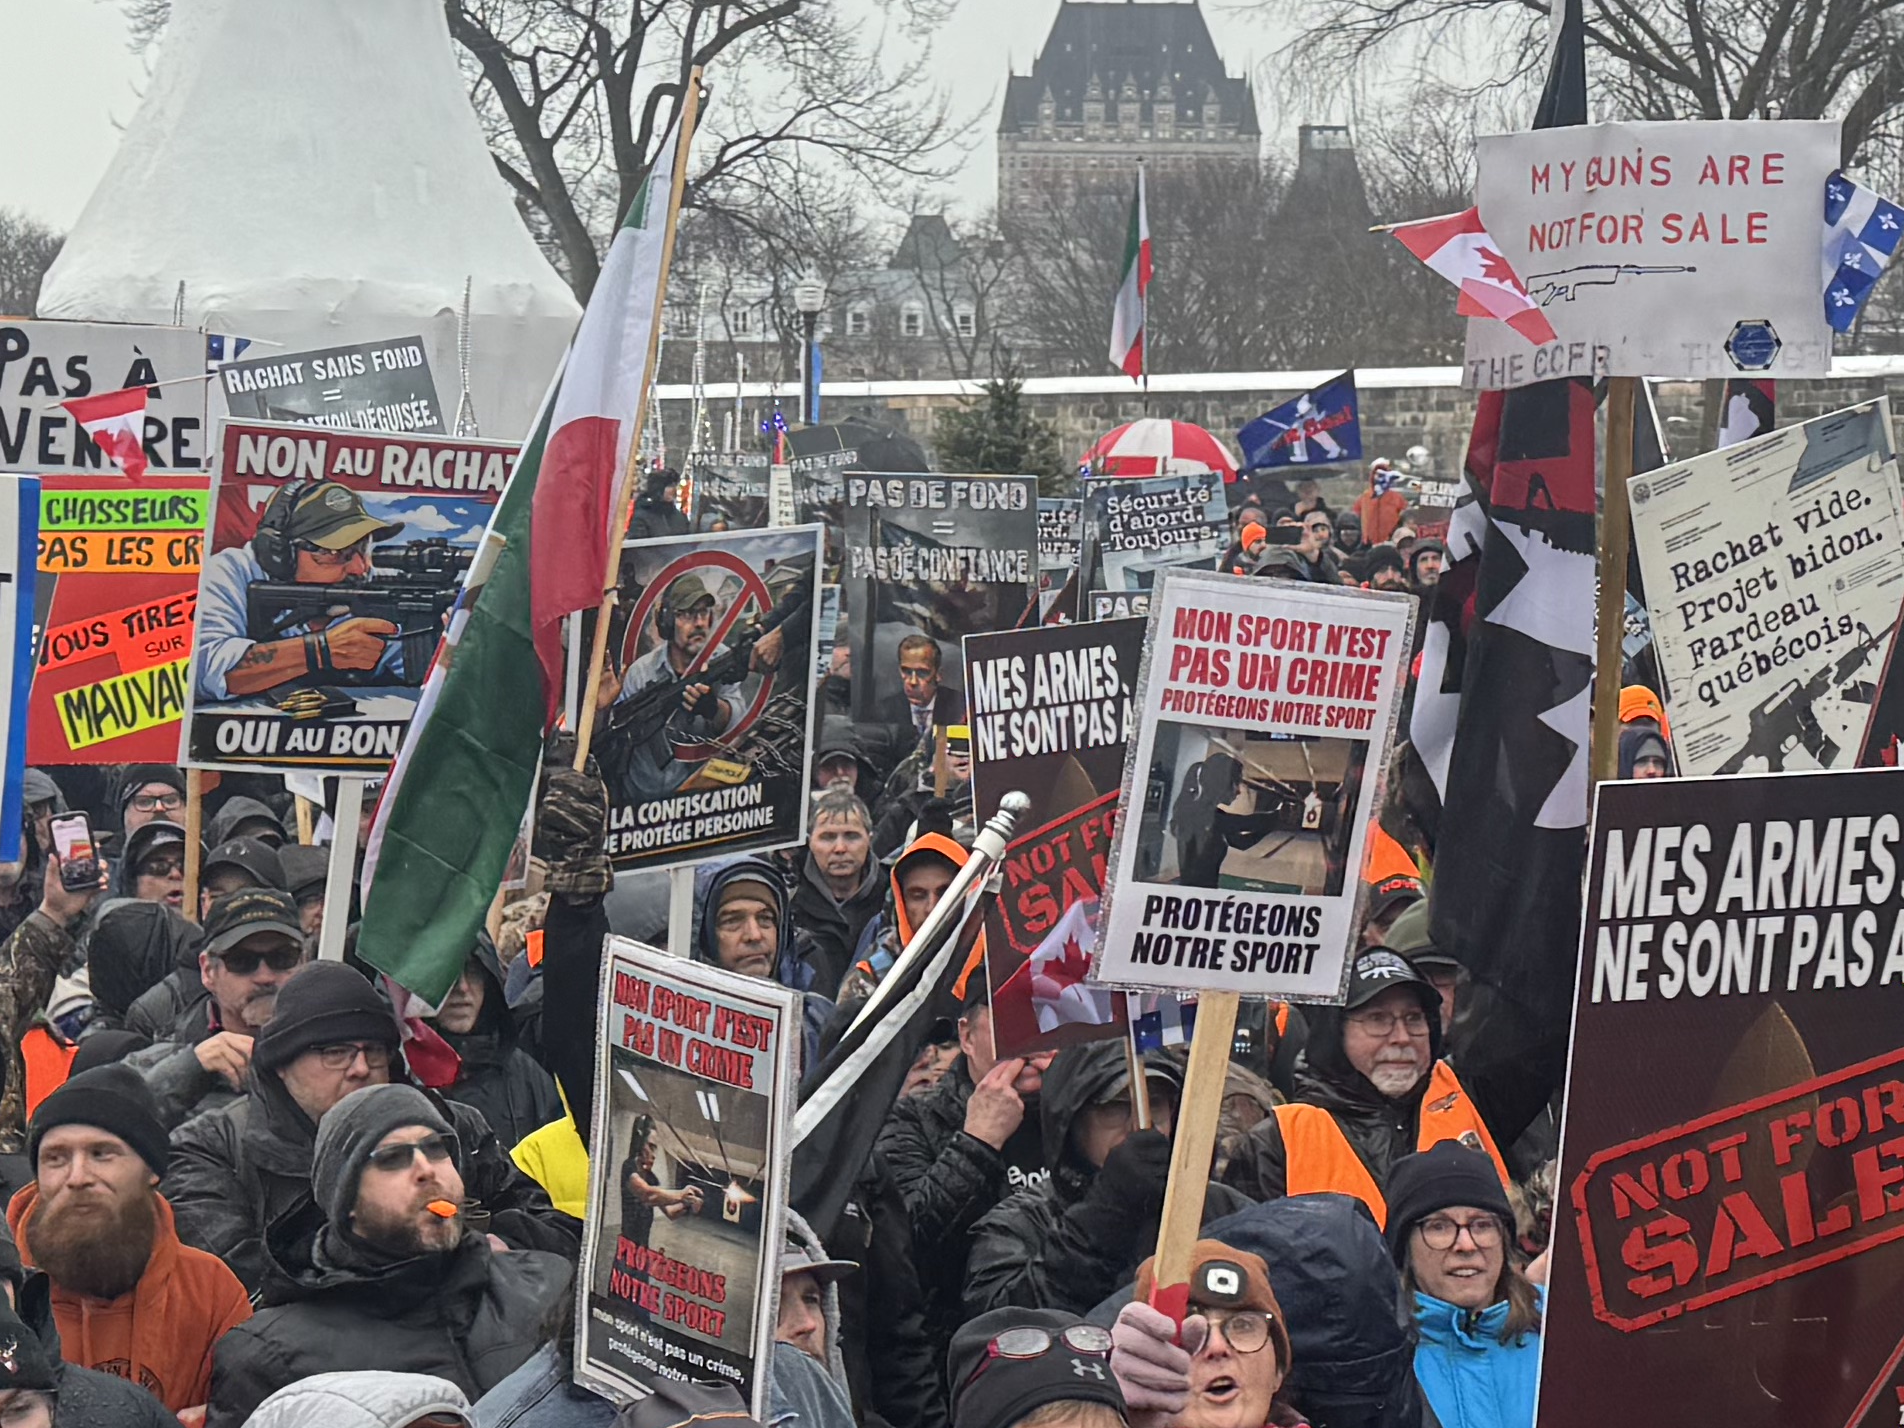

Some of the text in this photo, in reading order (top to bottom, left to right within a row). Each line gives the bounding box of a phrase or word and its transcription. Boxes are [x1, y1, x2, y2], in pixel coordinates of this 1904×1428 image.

[1531, 153, 1784, 194] MY GUNS ARE
[1529, 212, 1768, 252] NOT FOR SALE
[122, 345, 162, 400] À
[225, 344, 423, 394] RACHAT SANS FOND
[1468, 354, 1523, 389] THE
[236, 433, 328, 480] NON
[333, 447, 375, 477] AU
[46, 495, 197, 526] CHASSEURS
[848, 479, 1028, 511] PAS DE FOND
[1107, 485, 1210, 515] Sécurité
[1109, 507, 1204, 533] d'abord.
[1110, 525, 1220, 552] Toujours.
[1670, 488, 1872, 593] Rachat vide.
[37, 536, 154, 568] PAS LES
[851, 546, 892, 580] PAS
[1677, 525, 1883, 633] Projet bidon.
[145, 635, 184, 658] SUR
[1172, 607, 1392, 660] MON SPORT N'EST
[1686, 592, 1821, 671] Fardeau
[972, 644, 1120, 714] MES ARMES
[1168, 644, 1383, 702] PAS UN CRIME
[976, 699, 1118, 763] NE SONT PAS
[1160, 687, 1377, 732] PROTÉGEONS NOTRE SPORT
[215, 720, 400, 756] OUI AU BON
[609, 782, 763, 830] LA CONFISCATION
[696, 805, 775, 839] PERSONNE
[1004, 831, 1072, 888] NOT
[1599, 814, 1900, 919] MES ARMES
[1142, 894, 1323, 939] PROTÉGEONS
[1130, 931, 1227, 971] NOTRE
[1230, 939, 1321, 975] SPORT
[1591, 924, 1655, 1004] NE
[1658, 915, 1787, 999] SONT
[1786, 909, 1878, 991] PAS
[614, 970, 773, 1053] MON SPORT N'EST
[623, 1013, 755, 1091] PAS UN CRIME
[1610, 1132, 1747, 1219] NOT
[615, 1232, 727, 1305] PROTÉGEONS
[610, 1267, 726, 1340] NOTRE SPORT
[592, 1306, 705, 1369] mon sport pas un
